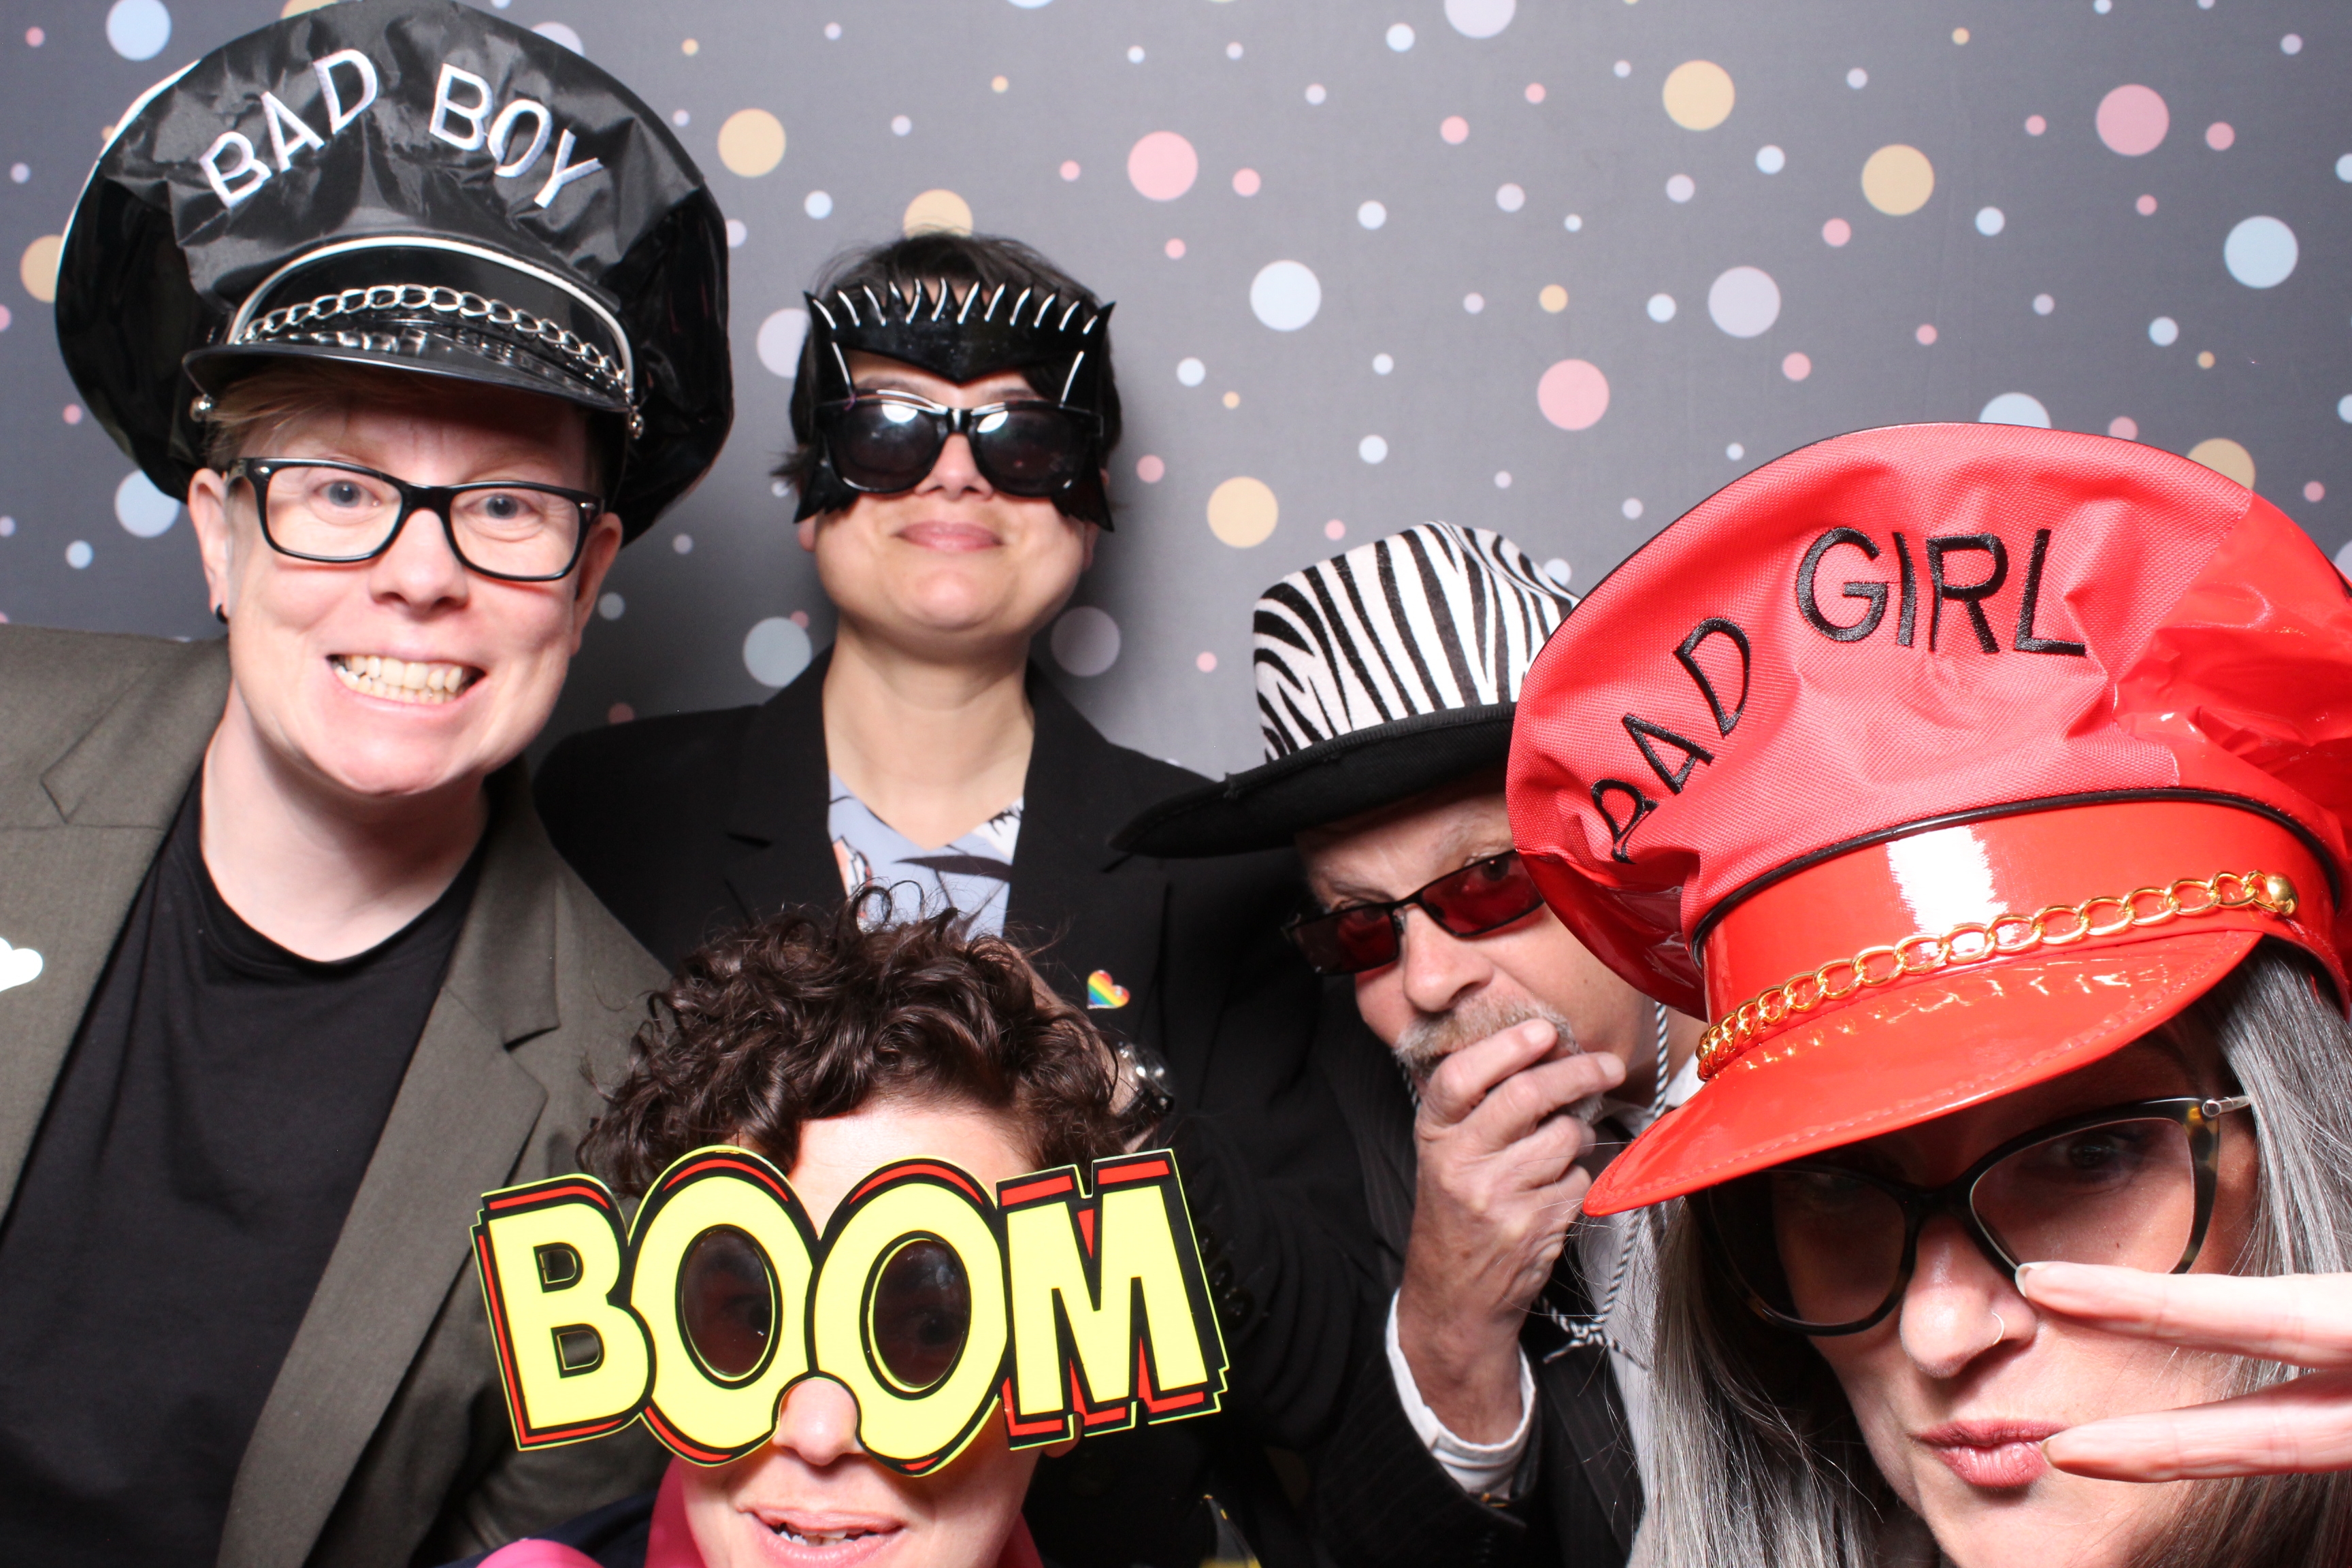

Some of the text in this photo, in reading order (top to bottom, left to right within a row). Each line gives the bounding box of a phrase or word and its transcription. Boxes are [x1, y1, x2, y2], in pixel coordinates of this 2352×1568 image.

[198, 48, 604, 209] BAD BOY
[1590, 526, 2087, 865] BAD GIRL
[475, 1147, 1225, 1474] BOOM
